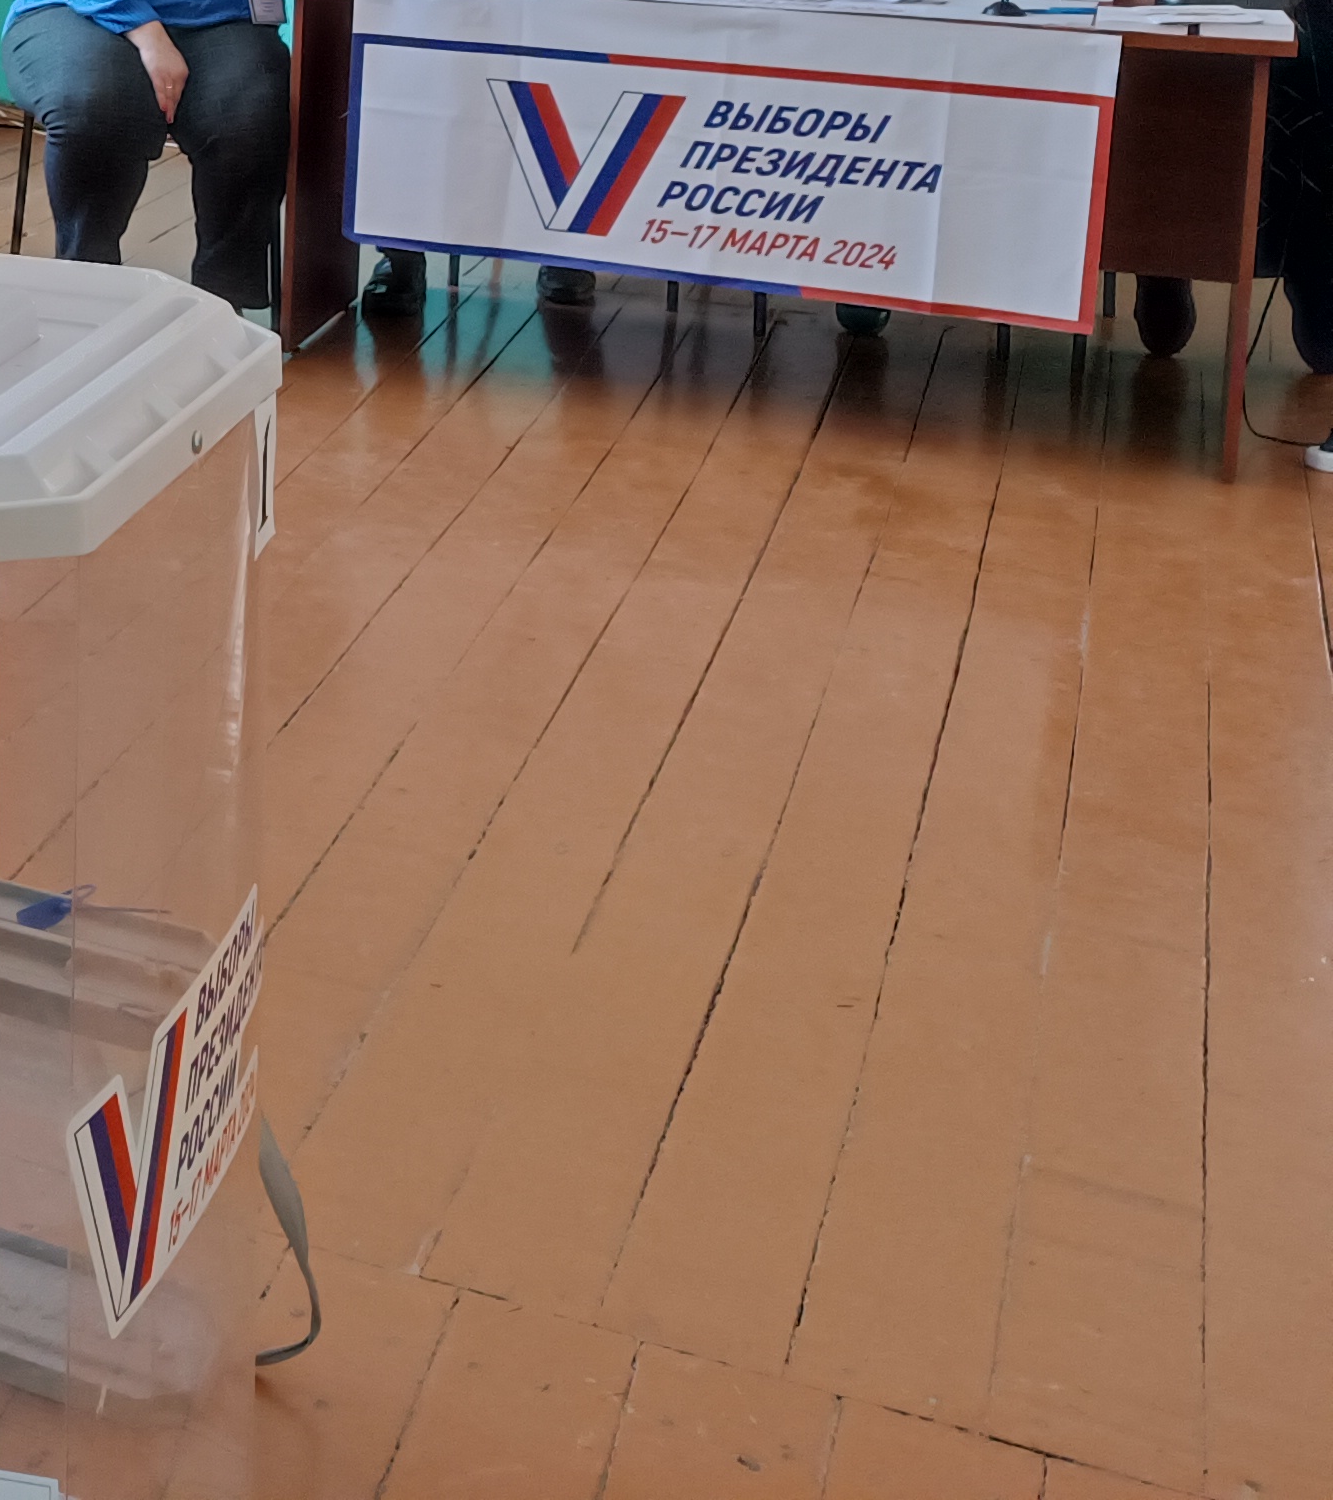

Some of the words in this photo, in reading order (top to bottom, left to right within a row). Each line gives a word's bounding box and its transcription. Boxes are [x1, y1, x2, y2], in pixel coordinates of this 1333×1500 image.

[703, 99, 892, 143] ВЫБОРЫ
[679, 140, 943, 193] ПРЕЗИДЕНТА
[656, 180, 825, 224] РОССИИ
[719, 227, 821, 263] МАРТА
[824, 239, 898, 272] 2024
[194, 900, 255, 1040] ВЫБОРЫ
